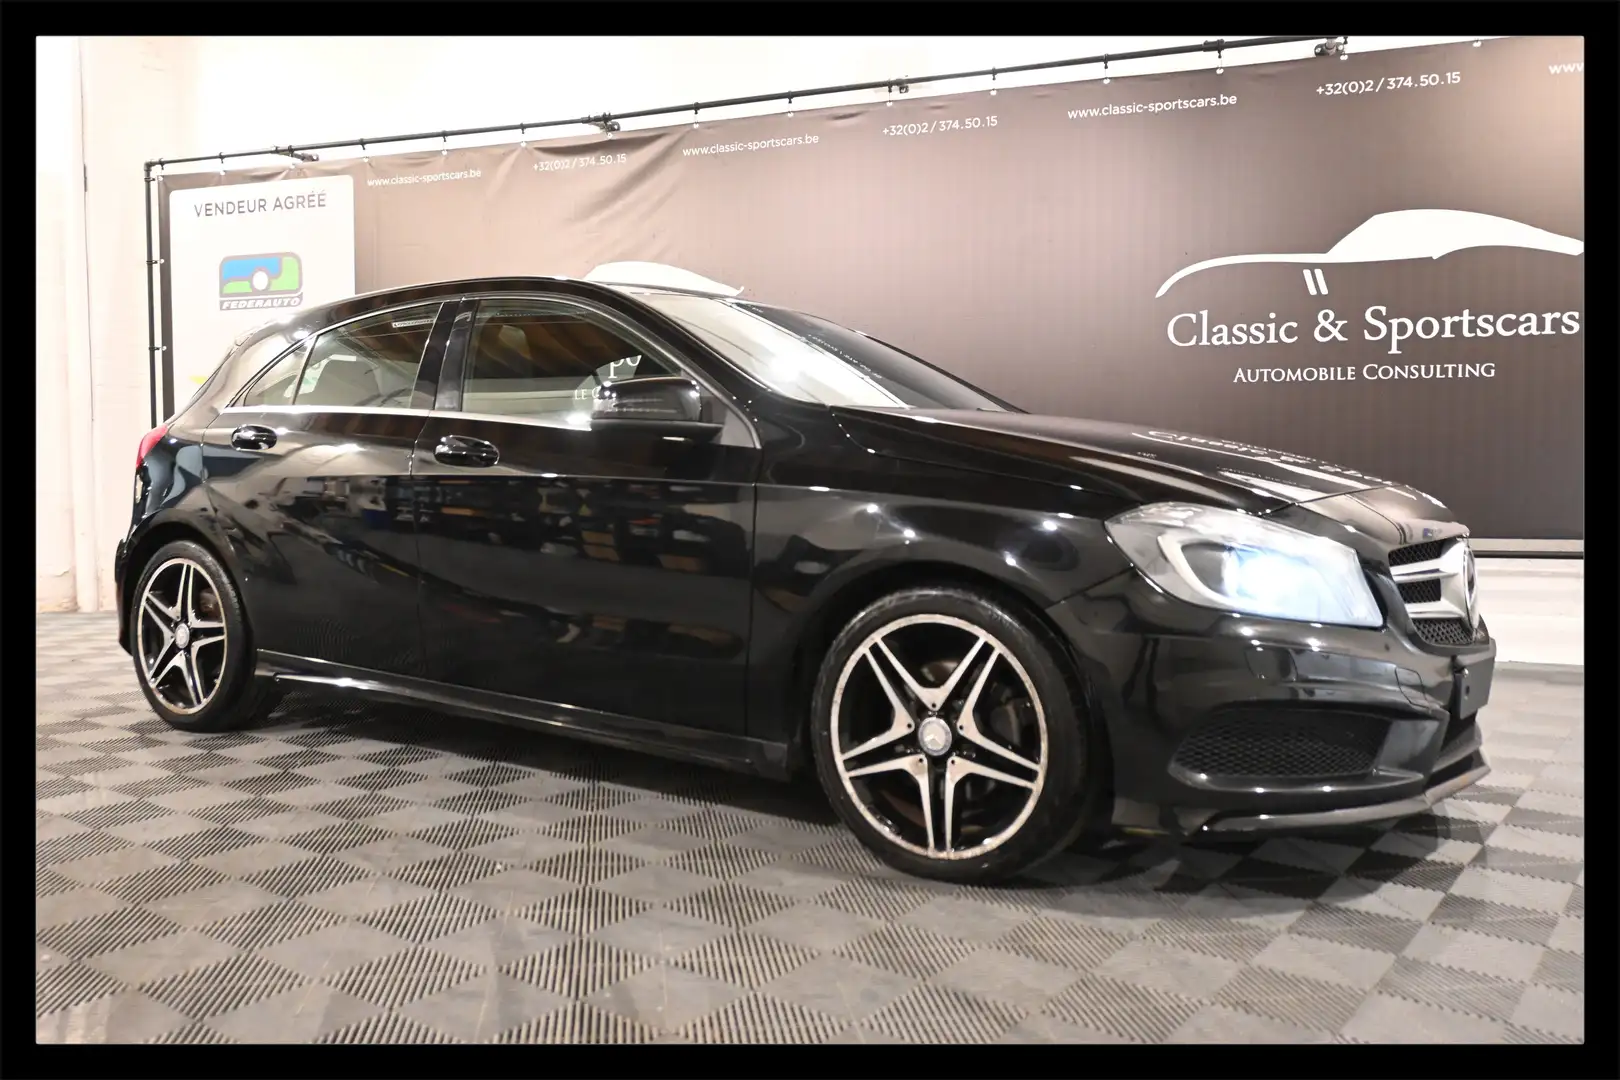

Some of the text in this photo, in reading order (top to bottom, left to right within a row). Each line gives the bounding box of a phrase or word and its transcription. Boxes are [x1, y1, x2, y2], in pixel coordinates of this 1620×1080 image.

[1067, 93, 1238, 120] www.classic-sportscars.be
[682, 133, 819, 157] www.classic-sportscars.be
[367, 168, 482, 187] www.classic-sportscars.be
[194, 189, 327, 218] VENDEUR AGRÉÉ
[222, 297, 300, 310] FEDERAUTO
[1167, 305, 1580, 355] Classic & Sportscars
[1233, 362, 1496, 383] AUTOMOBILE CONSULTING
